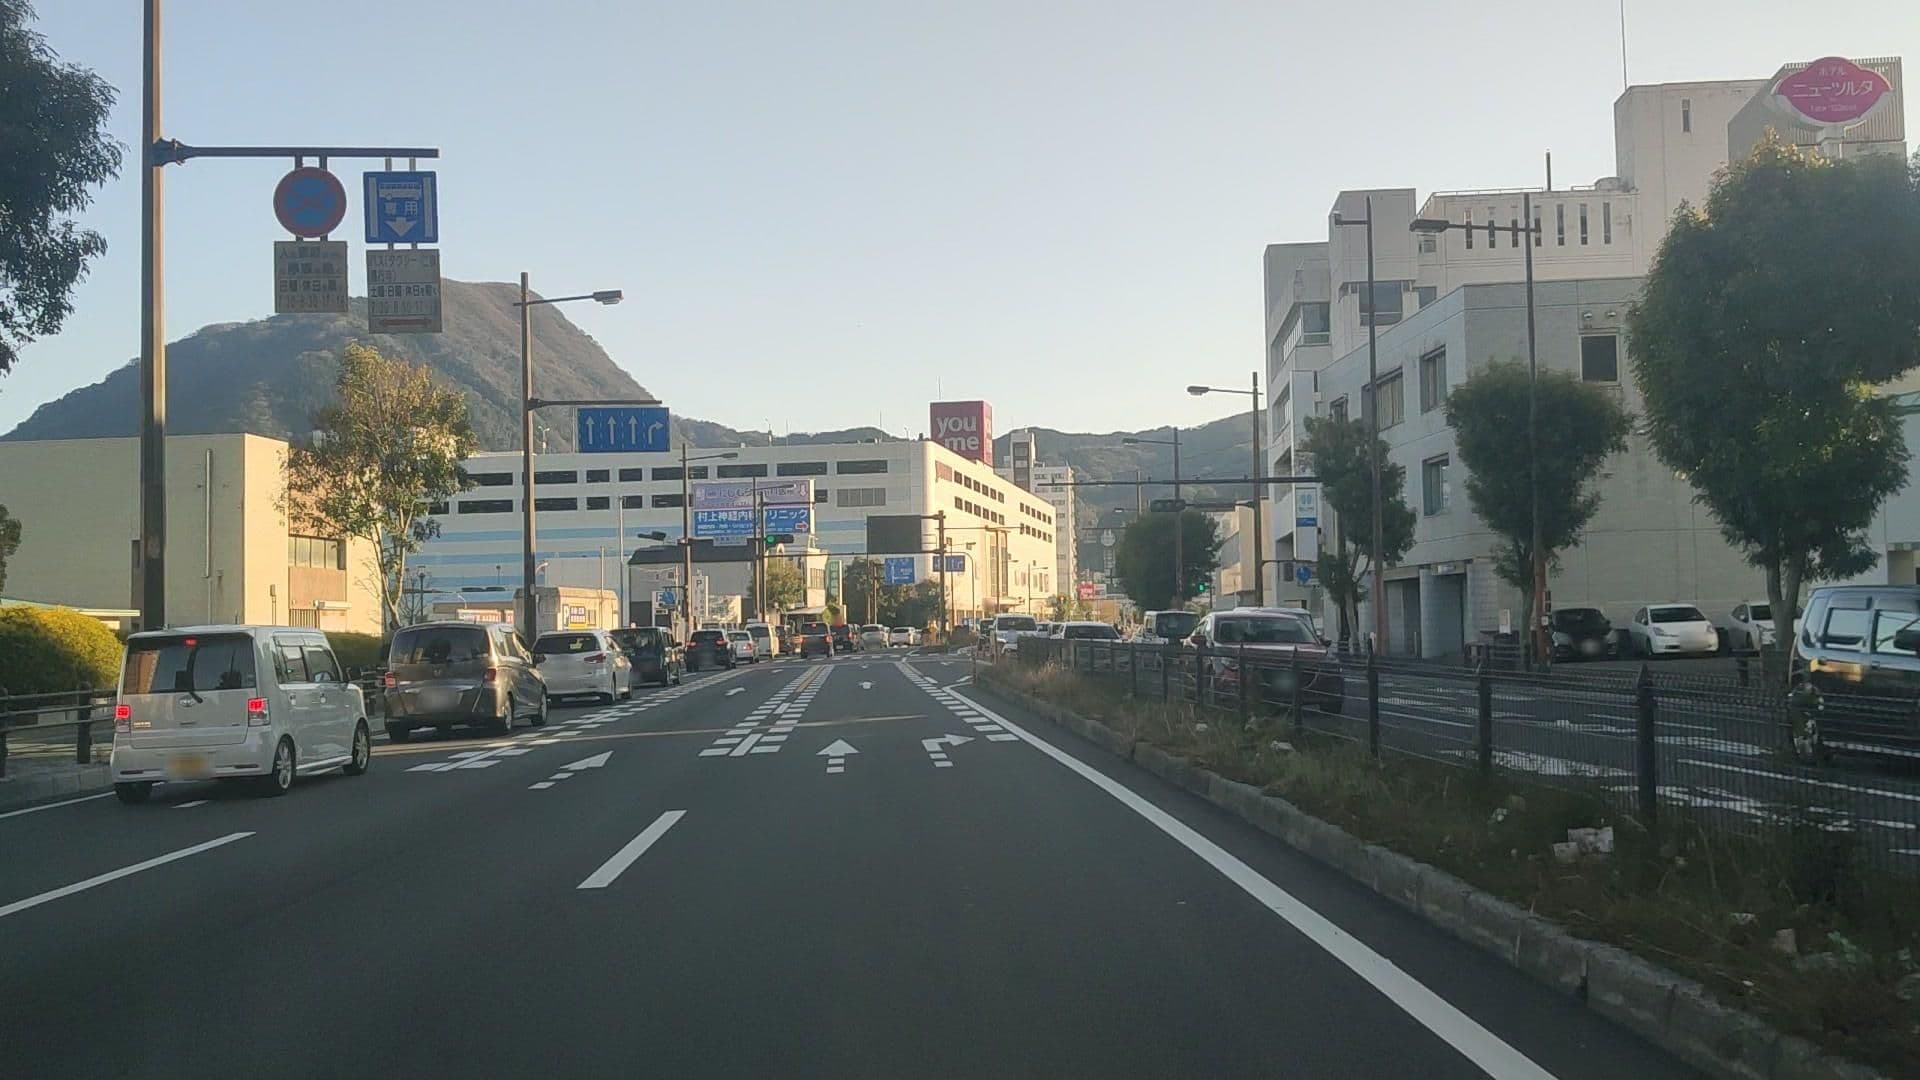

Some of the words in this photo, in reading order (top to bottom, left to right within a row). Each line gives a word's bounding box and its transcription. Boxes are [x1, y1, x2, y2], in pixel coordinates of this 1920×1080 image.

[1792, 80, 1873, 97] ニューツルタ
[936, 415, 977, 438] you
[944, 435, 979, 451] me
